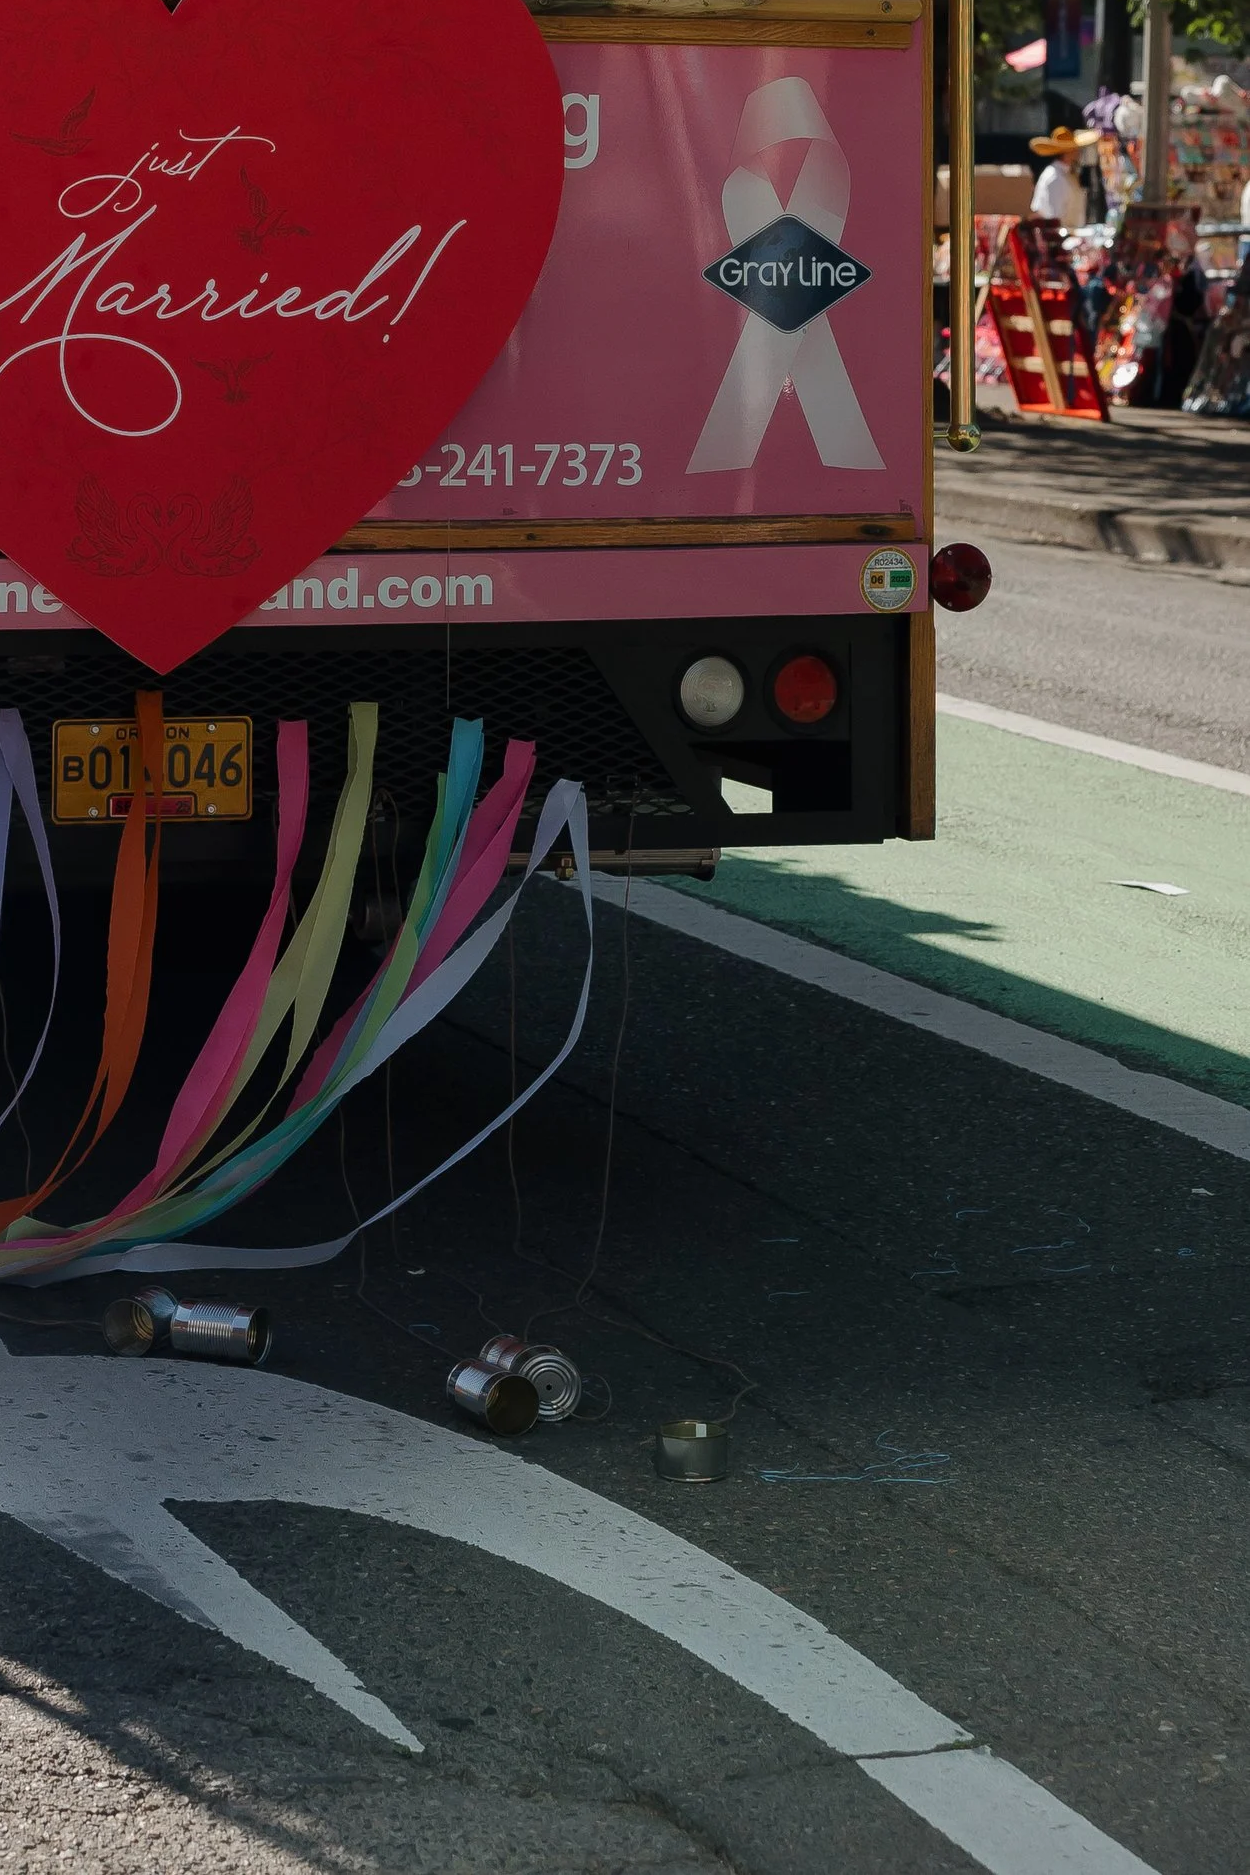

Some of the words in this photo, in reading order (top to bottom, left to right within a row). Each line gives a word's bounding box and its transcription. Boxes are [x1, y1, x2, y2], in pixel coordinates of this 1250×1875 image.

[58, 125, 276, 219] just
[719, 258, 793, 287] Gray
[798, 256, 857, 287] Line
[870, 575, 884, 585] 06
[116, 726, 190, 741] ORON
[62, 743, 243, 789] B01046
